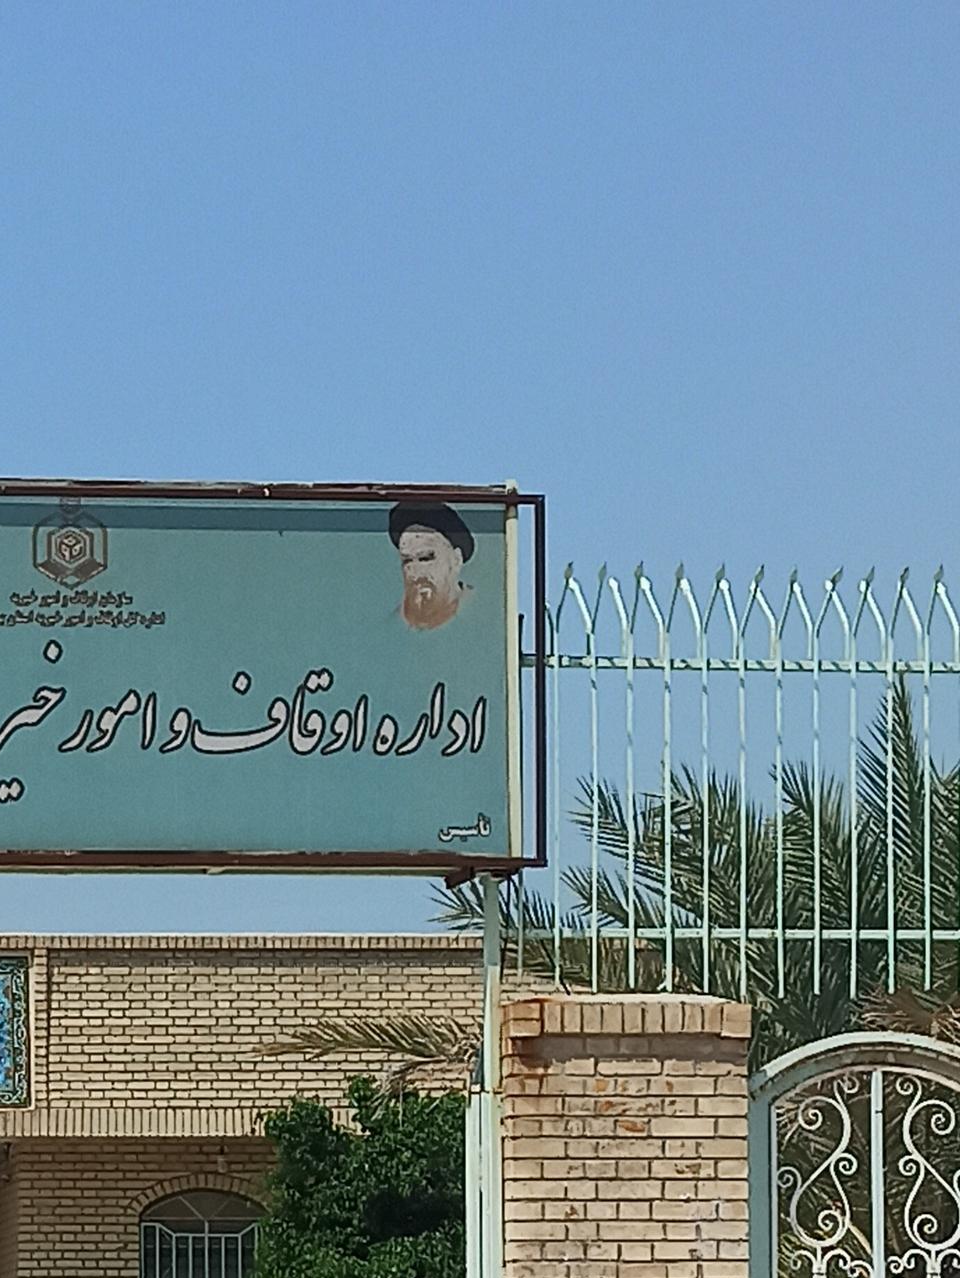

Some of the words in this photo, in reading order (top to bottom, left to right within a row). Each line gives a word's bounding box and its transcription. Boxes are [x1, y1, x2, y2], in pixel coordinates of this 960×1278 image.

[8, 588, 38, 607] خیریه
[39, 589, 60, 608] امور
[60, 594, 69, 608] و
[69, 590, 98, 608] اوقاف
[7, 609, 34, 627] استان
[35, 610, 63, 627] خیریه
[62, 609, 85, 628] امور
[95, 610, 123, 628] اوقاف
[139, 611, 166, 629] اداره
[58, 688, 157, 753] امور
[191, 667, 368, 756] اوقاف
[373, 682, 487, 756] اداره
[159, 707, 191, 754] و
